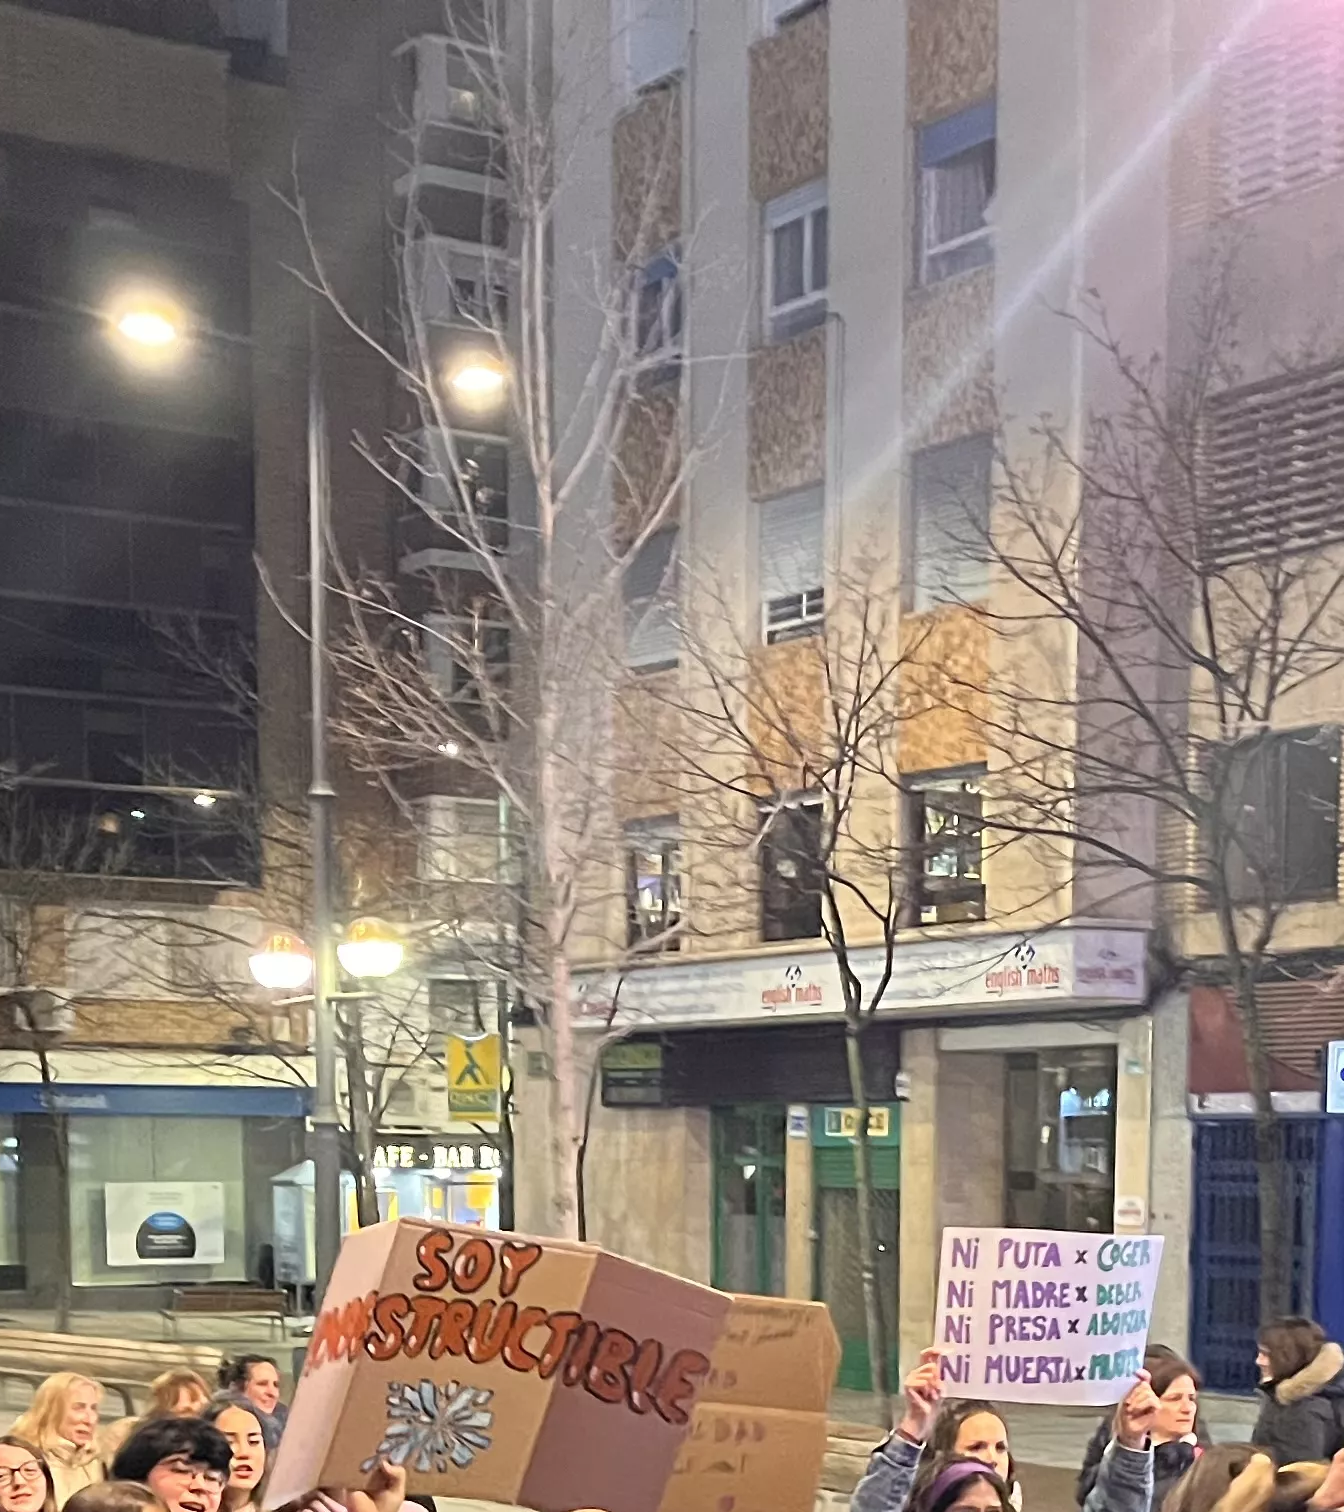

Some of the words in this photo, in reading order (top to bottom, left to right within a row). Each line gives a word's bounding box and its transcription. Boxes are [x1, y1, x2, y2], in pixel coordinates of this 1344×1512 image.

[986, 969, 1022, 997] english
[1027, 963, 1060, 987] maths
[373, 1144, 415, 1168] AFE
[413, 1228, 542, 1298] SOY
[997, 1237, 1062, 1270] PUTA
[1096, 1238, 1151, 1272] COGER
[991, 1279, 1072, 1309] MADRE
[988, 1313, 1061, 1345] PRESA
[984, 1355, 1073, 1384] MUERTA
